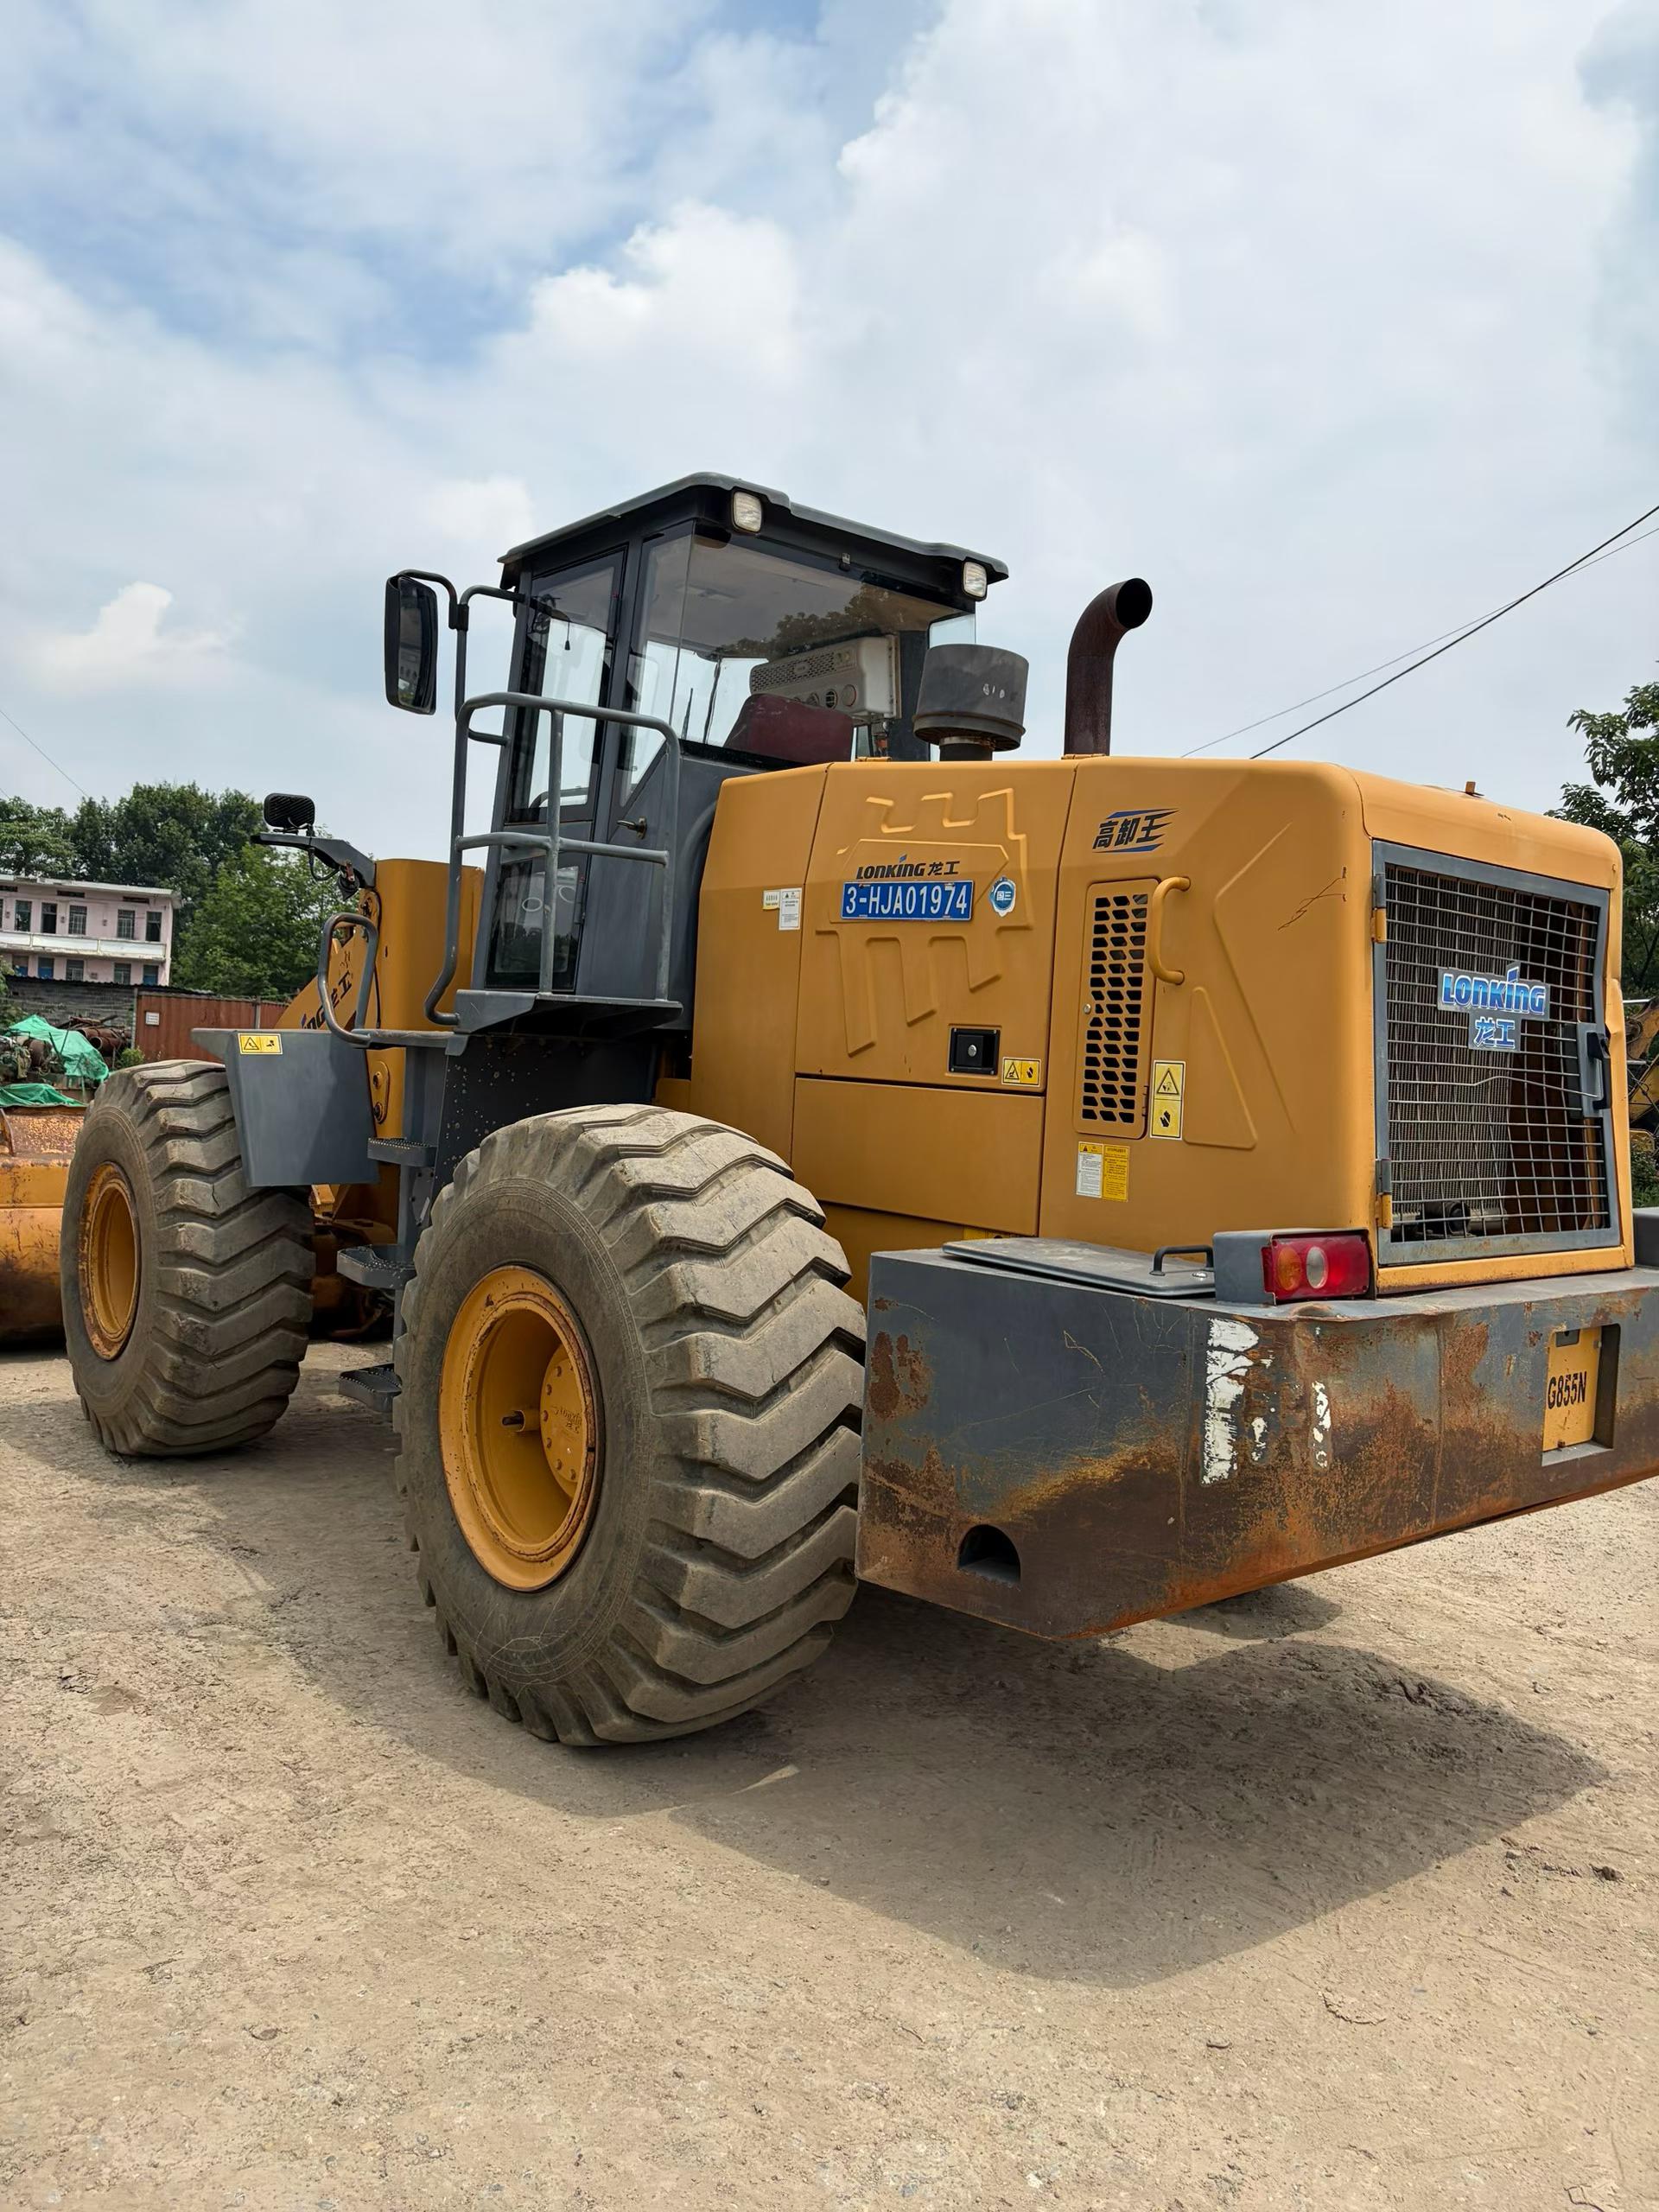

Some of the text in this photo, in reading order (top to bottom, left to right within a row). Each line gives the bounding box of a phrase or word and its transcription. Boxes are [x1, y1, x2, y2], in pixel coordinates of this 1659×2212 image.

[1092, 810, 1179, 849] 高卸王
[927, 860, 961, 876] 龙工
[845, 884, 968, 915] 3-HJA01974
[1473, 1016, 1516, 1049] 龙工
[1548, 1370, 1587, 1409] G855N
